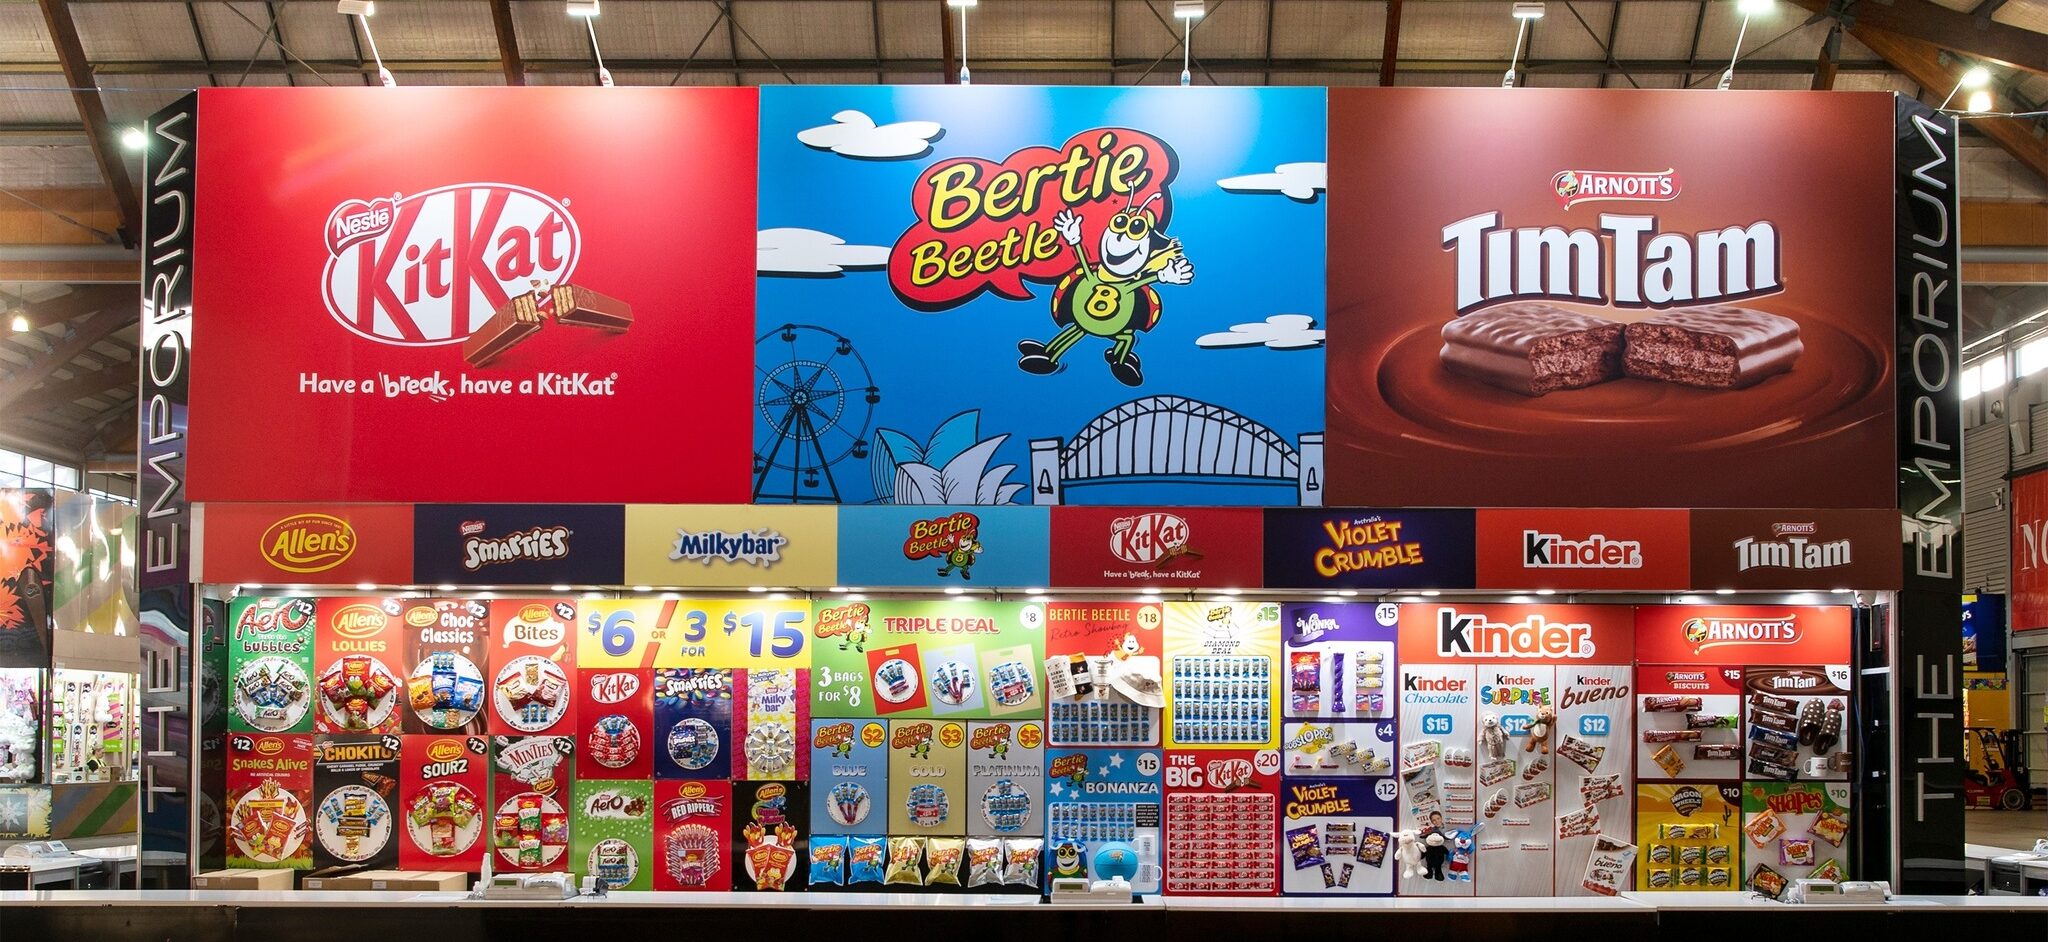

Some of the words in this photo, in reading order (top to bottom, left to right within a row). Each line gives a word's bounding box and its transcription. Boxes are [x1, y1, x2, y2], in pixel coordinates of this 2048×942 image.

[927, 132, 1148, 231] Bertie
[1580, 174, 1673, 196] ARNOTT'S
[911, 222, 1061, 287] Beetle
[356, 188, 564, 341] KitKat
[147, 112, 190, 572] EMPORIUM
[1912, 115, 1953, 578] EMPORIUM
[299, 372, 356, 395] Have
[361, 378, 375, 394] a
[460, 374, 512, 395] have
[518, 378, 533, 395] a
[537, 372, 616, 397] KitKat
[914, 514, 972, 539] Bertie
[1121, 514, 1184, 561] KitKat
[1325, 521, 1401, 549] VIOLET
[270, 528, 350, 563] Allen's
[680, 533, 778, 559] Milkybar
[909, 537, 949, 554] Beetle
[1316, 541, 1423, 576] CRUMBLE
[1104, 570, 1121, 578] Have
[1153, 570, 1169, 578] have
[1176, 570, 1201, 578] KitKat
[295, 600, 313, 615] $12
[521, 606, 550, 621] Allen's
[556, 602, 574, 621] $12
[822, 604, 864, 623] Bertie
[1050, 609, 1087, 621] BERTIE
[1091, 609, 1131, 621] BEETLE
[1257, 607, 1280, 622] $15
[1378, 607, 1396, 619] $15
[336, 611, 384, 635] Allen's
[409, 609, 437, 623] Allen's
[440, 612, 475, 628] Choc
[1025, 612, 1037, 623] $8
[1138, 612, 1157, 624] $18
[514, 625, 559, 640] Bites
[588, 610, 636, 657] $6
[684, 610, 708, 643] 3
[723, 611, 806, 658] $15
[884, 617, 946, 634] TRIPLE
[950, 618, 1000, 635] DEAL
[1707, 620, 1795, 640] ARNOTT'S
[421, 628, 474, 644] Classics
[651, 631, 667, 640] OR
[243, 641, 300, 653] bubbles
[332, 641, 387, 652] LOLLIES
[681, 646, 706, 657] FOR
[818, 666, 832, 687] 3
[834, 672, 864, 681] BAGS
[1673, 672, 1705, 681] ARNOTT'S
[1724, 670, 1741, 680] $15
[1832, 671, 1848, 680] $16
[600, 675, 635, 702] KitKat
[665, 674, 723, 696] SMARTIES
[761, 694, 787, 705] Milky
[818, 691, 841, 702] FOR
[843, 685, 861, 707] $8
[1404, 692, 1468, 704] Chocolate
[1480, 686, 1551, 706] SURPRISE
[1560, 686, 1629, 709] bueno
[765, 704, 781, 712] bar
[147, 646, 181, 814] THE
[818, 724, 850, 738] Bertie
[896, 724, 929, 738] Bertie
[974, 724, 1008, 739] Bertie
[1378, 724, 1394, 737] $4
[1426, 718, 1449, 731] $15
[1504, 719, 1526, 731] $12
[1584, 719, 1606, 732] $12
[382, 735, 400, 751] $12
[864, 727, 883, 743] $2
[941, 727, 961, 745] $3
[1019, 728, 1040, 744] $5
[1917, 654, 1955, 821] THE
[233, 737, 251, 751] $12
[258, 740, 282, 752] Allen's
[431, 743, 461, 759] Allen's
[468, 738, 485, 755] $12
[555, 739, 573, 755] $12
[324, 745, 393, 762] CHOKITO
[508, 742, 554, 769] MINTIES
[1053, 754, 1086, 769] Bertie
[1169, 755, 1196, 766] THE
[1257, 754, 1279, 767] $20
[232, 758, 274, 771] Snakes
[275, 758, 308, 771] Alive
[422, 760, 468, 779] SOURZ
[832, 765, 867, 777] BLUE
[909, 765, 946, 777] GOLD
[973, 765, 1041, 777] PLATINUM
[1137, 758, 1157, 771] $15
[1165, 768, 1203, 787] BIG
[1215, 761, 1250, 787] KitKat
[682, 785, 704, 797] Allen's
[1085, 782, 1159, 794] BONANZA
[1292, 786, 1337, 803] VIOLET
[1377, 784, 1396, 795] $12
[1723, 788, 1740, 798] $10
[1831, 789, 1848, 799] $10
[591, 796, 624, 815] Aero
[671, 804, 688, 819] RED
[687, 803, 716, 814] RIPPERZ
[1286, 799, 1351, 820] CRUMBLE
